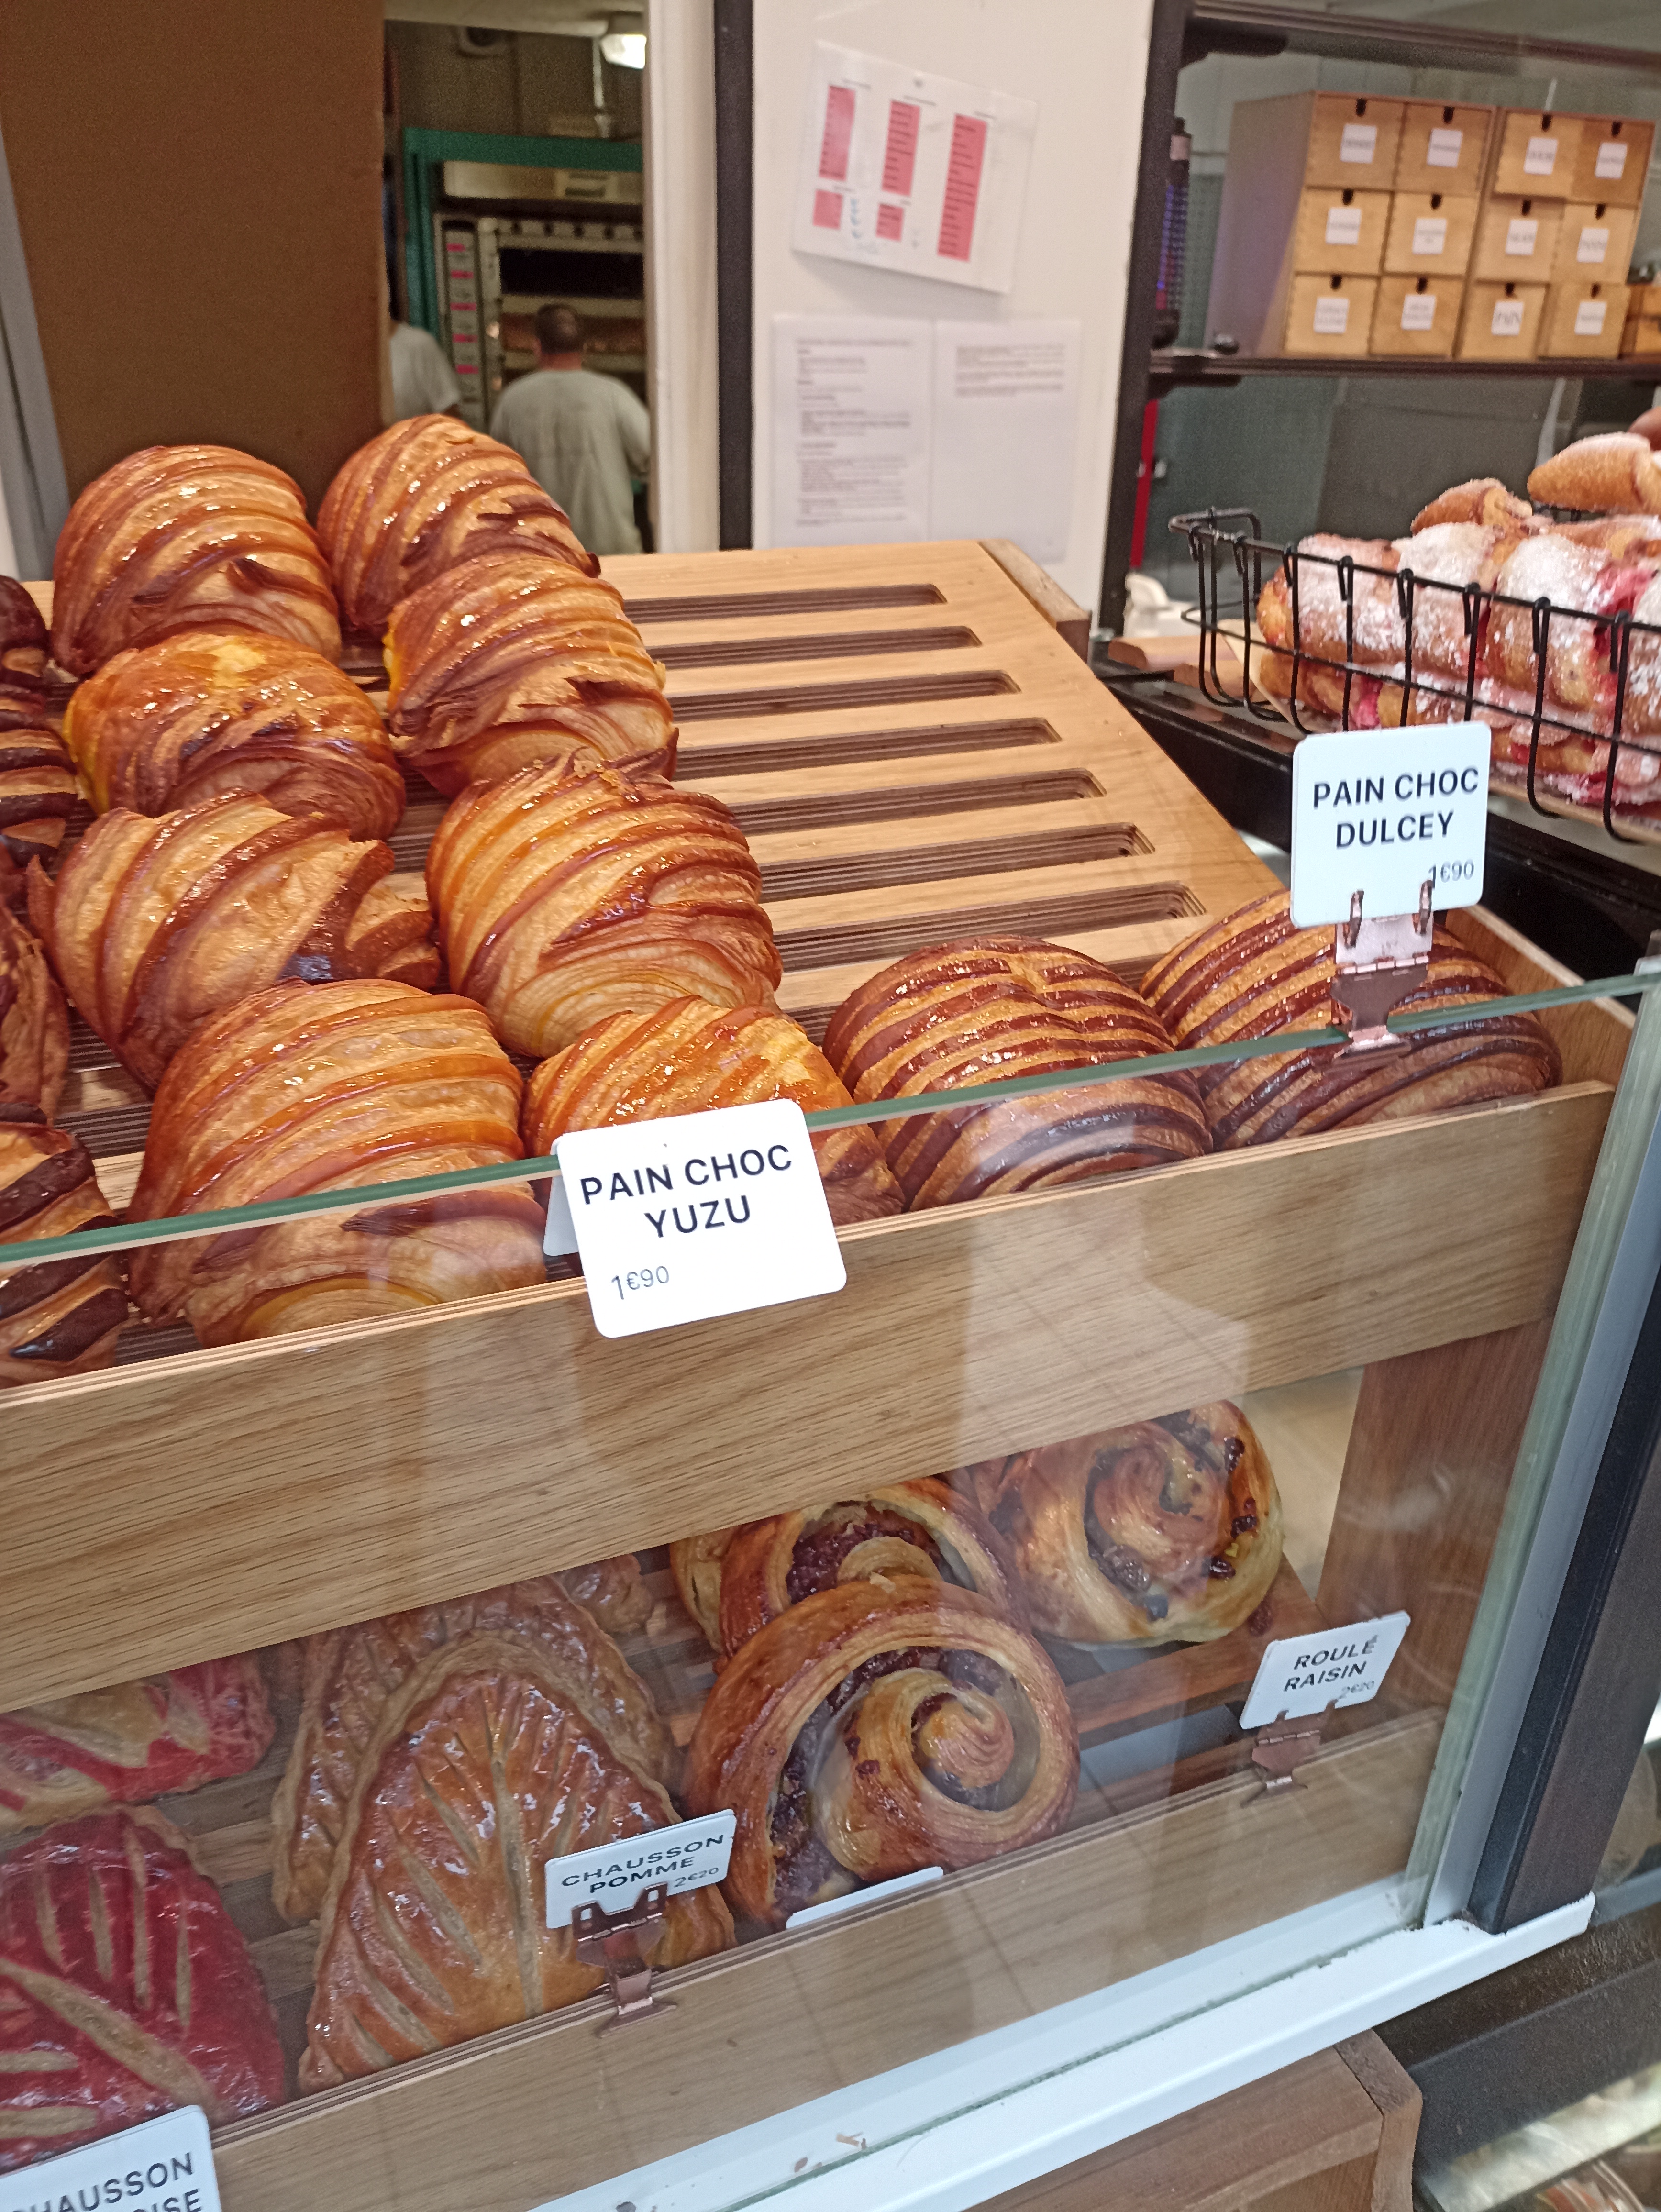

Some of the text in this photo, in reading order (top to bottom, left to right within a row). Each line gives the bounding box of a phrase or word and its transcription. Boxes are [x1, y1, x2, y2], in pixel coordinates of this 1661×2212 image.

[1314, 767, 1479, 809] PAIN CHOC
[1337, 810, 1454, 849] DULCEY
[1428, 860, 1474, 889] 1€90
[580, 1144, 792, 1205] PAIN CHOC
[644, 1195, 751, 1238] YUZU
[611, 1265, 670, 1300] 1€90
[1283, 1661, 1367, 1692] RAISIN
[562, 1835, 724, 1887] CHAUSSON
[589, 1856, 695, 1893] POMME
[674, 1867, 719, 1888] 2€20
[11, 2153, 193, 2212] AUSSON
